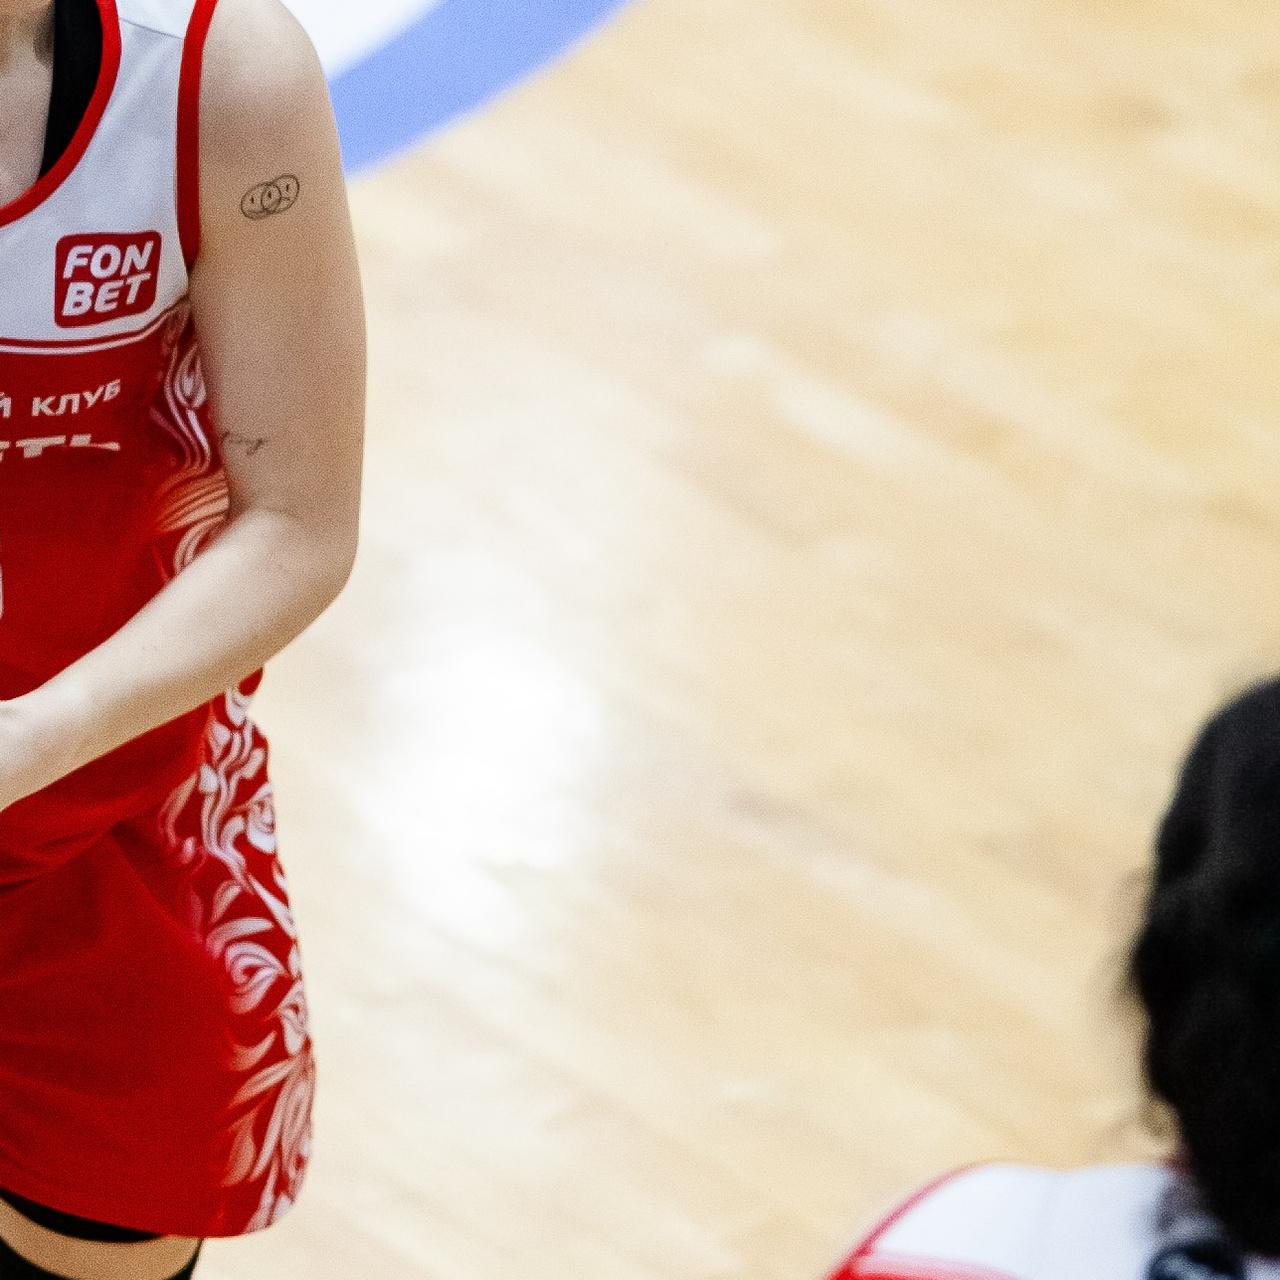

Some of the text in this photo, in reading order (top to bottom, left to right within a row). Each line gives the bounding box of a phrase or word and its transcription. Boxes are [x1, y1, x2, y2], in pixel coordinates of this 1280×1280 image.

[62, 240, 154, 279] FON
[61, 272, 152, 317] BET
[31, 378, 121, 418] КЛУБ
